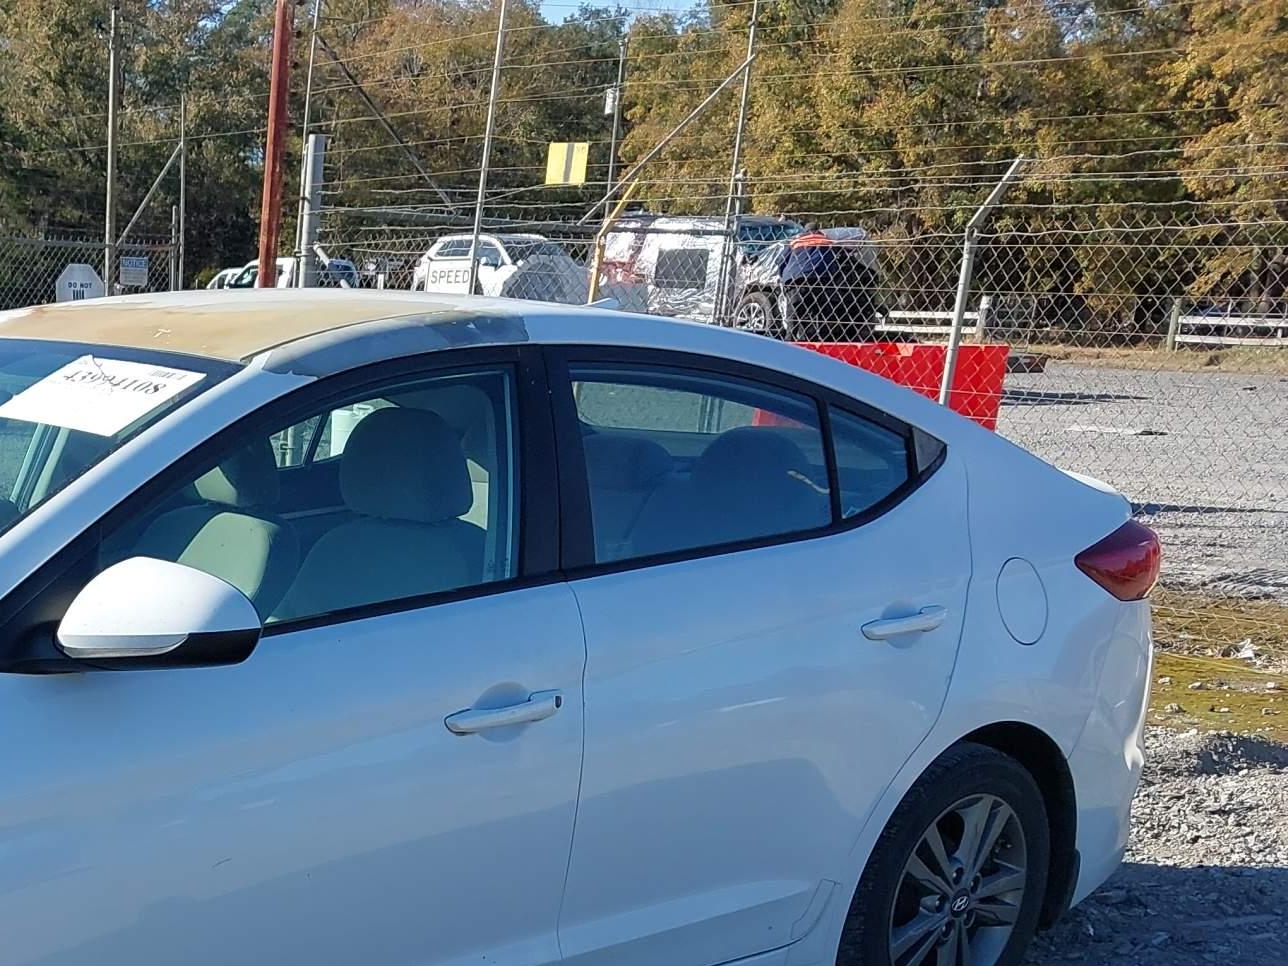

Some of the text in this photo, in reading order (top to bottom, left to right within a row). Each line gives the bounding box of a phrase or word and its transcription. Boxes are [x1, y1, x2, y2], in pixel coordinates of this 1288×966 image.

[121, 258, 146, 266] NOTICE
[430, 270, 470, 284] SPEED
[68, 281, 93, 289] DO NOT
